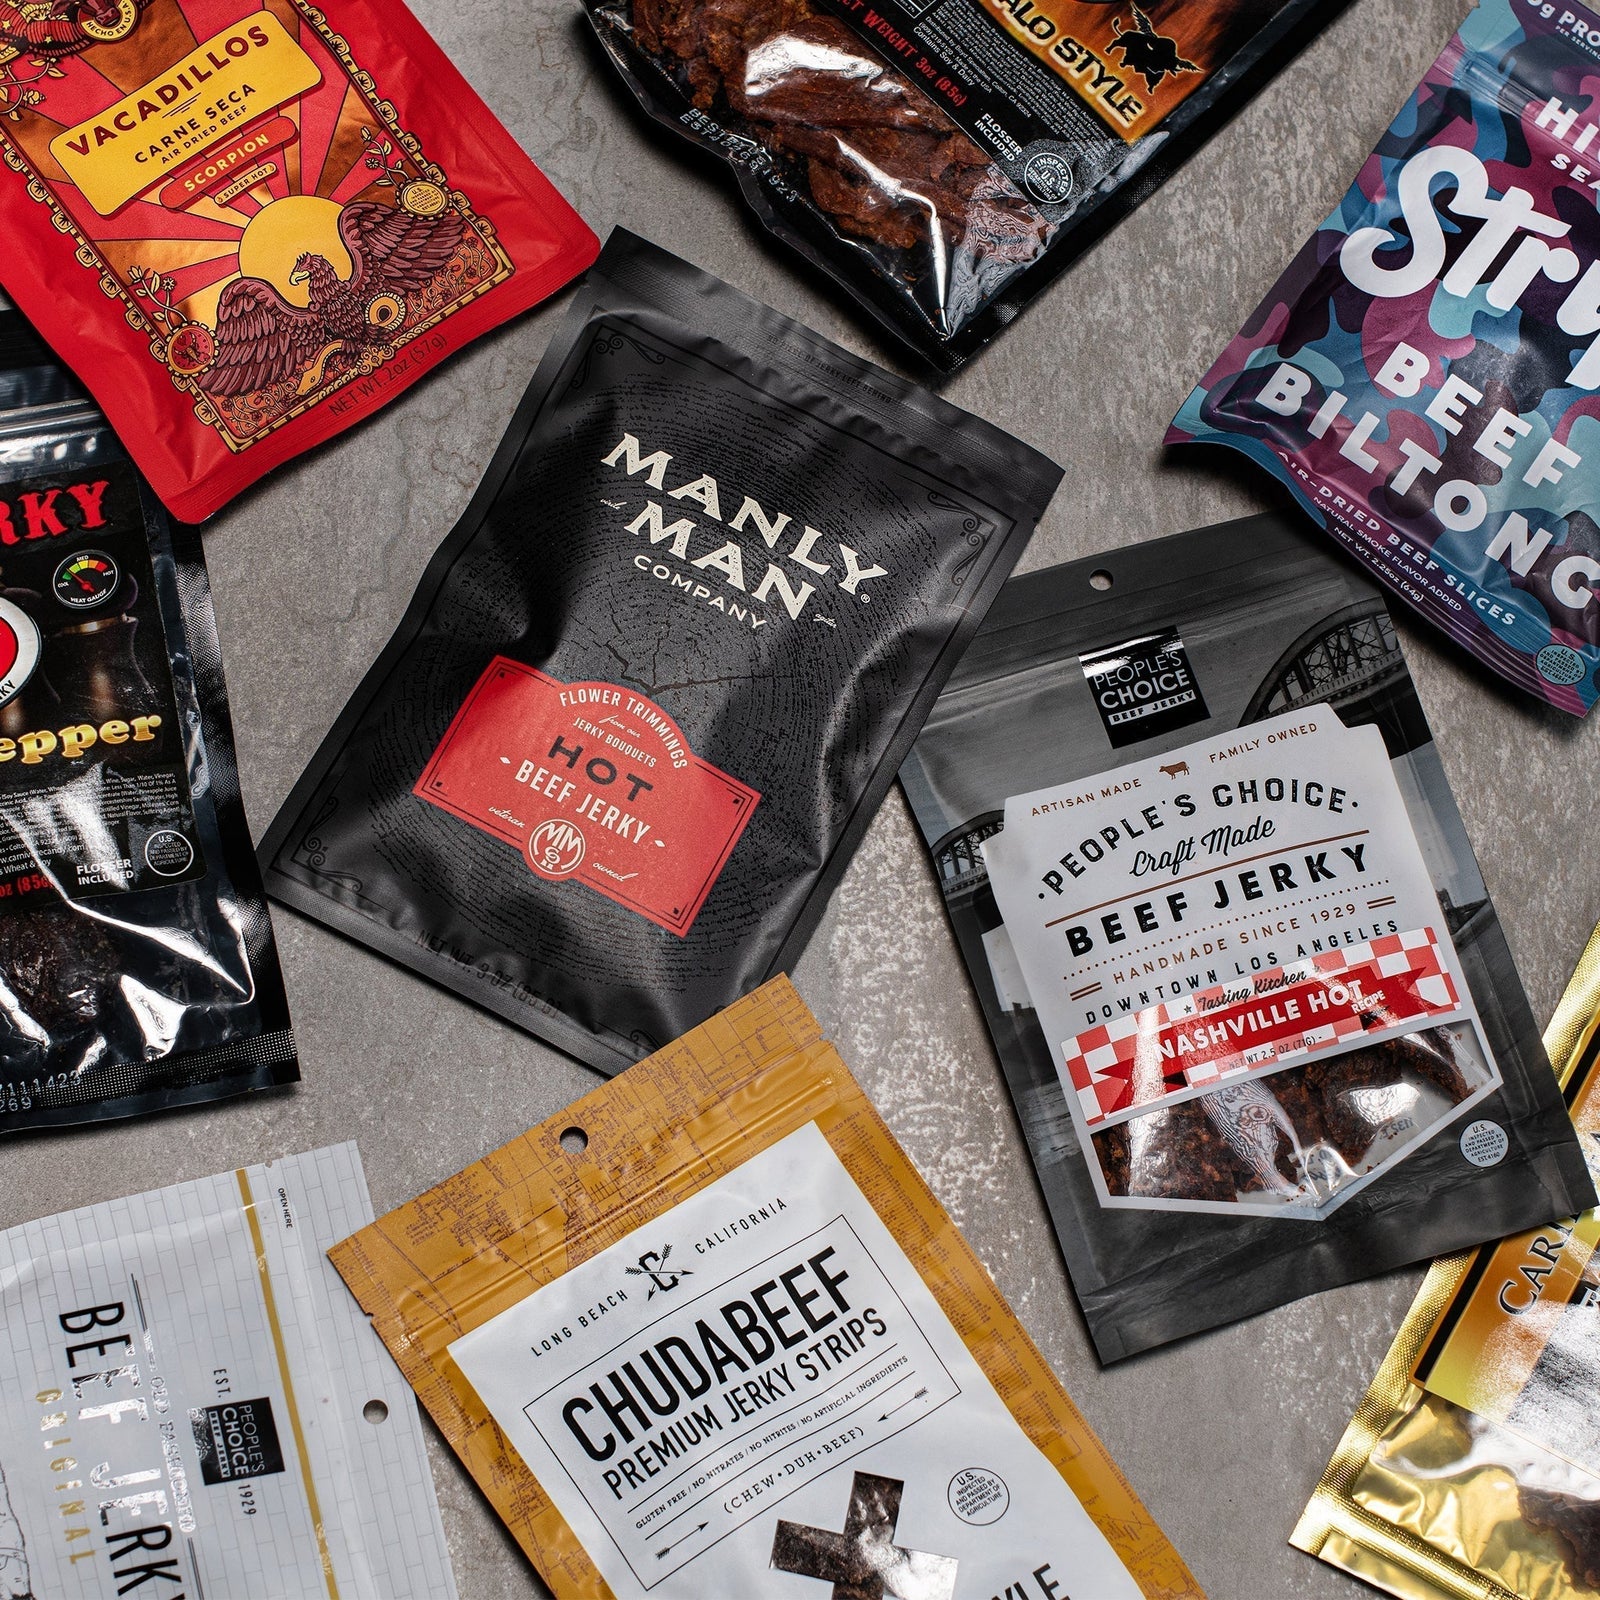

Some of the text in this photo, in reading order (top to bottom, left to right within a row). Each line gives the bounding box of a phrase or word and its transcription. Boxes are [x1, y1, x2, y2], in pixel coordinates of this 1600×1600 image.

[86, 20, 114, 37] HECHO
[113, 21, 127, 36] EN
[863, 9, 919, 58] WEIGHT
[1555, 25, 1570, 37] PER
[913, 26, 941, 53] Contains
[940, 51, 953, 65] Soy
[958, 68, 975, 86] Dairy
[925, 16, 952, 42] Distributed
[955, 45, 968, 59] Boyd
[1008, 95, 1017, 104] CA
[1053, 36, 1144, 124] STYLE
[65, 25, 270, 156] VACADILLOS
[980, 81, 993, 93] USA
[135, 83, 256, 164] CARNE SECA
[161, 105, 249, 164] AIR DRIED BEEF
[974, 119, 1016, 162] INCLUDED
[981, 112, 1023, 156] FLOSSER
[184, 133, 270, 192] SCORPION
[223, 167, 269, 199] SUPER HOT
[1036, 157, 1069, 194] INSPECTED
[1041, 170, 1056, 187] U.S.
[328, 333, 448, 417] NET WT. 2oz (57g)
[1374, 341, 1581, 489] BEEF
[1255, 362, 1600, 609] BILTONG
[601, 432, 889, 596] MANLY
[1278, 451, 1517, 626] AIR-DRIED BEEF SLICES
[76, 555, 89, 563] MED
[102, 569, 115, 577] HOT
[624, 500, 816, 620] MAN
[1313, 496, 1463, 611] NATURAL SMOKE FLAVOR ADDED
[1334, 526, 1424, 603] NET WT. 2.25oz (64g)
[70, 588, 108, 604] HEAT GAUGE
[634, 555, 768, 629] COMPANY
[1093, 650, 1182, 690] PEOPLE'S
[1100, 668, 1190, 709] CHOICE
[559, 688, 688, 769] FLOWER TRIMMINGS
[598, 714, 626, 730] from
[1112, 690, 1194, 722] BEEF JERKY
[573, 717, 657, 768] JERKY BOUQUETS
[547, 735, 654, 802] HOT
[1032, 722, 1318, 817] ARTISAN MADE FAMILY OWNED
[488, 805, 526, 829] veteran
[514, 759, 651, 844] BEEF JERKY
[158, 835, 174, 843] U.S.
[1129, 815, 1276, 877] Craft Made
[3, 862, 29, 875] Wheat
[76, 858, 132, 876] FLOSSER
[78, 870, 134, 885] INCLUDED
[592, 862, 639, 882] owned
[1065, 843, 1366, 957] BEEF JERKY
[415, 929, 448, 956] NET
[1113, 903, 1357, 984] HANDMADE SINCE 1929
[1085, 920, 1399, 1025] DOWNTOWN LOS ANGELES
[1199, 969, 1307, 1012] Tasting Kitchen
[1153, 979, 1364, 1062] NASHVILLE HOT
[1351, 990, 1386, 1014] RECIPE
[1246, 1052, 1260, 1065] WT
[1261, 1047, 1277, 1060] 2.5
[1279, 1043, 1292, 1055] OZ
[1465, 1140, 1497, 1153] DEPARTMENT
[1469, 1130, 1495, 1141] INSPECTED
[1471, 1144, 1503, 1157] AGRICULTURE
[1472, 1123, 1487, 1134] U.S.
[1476, 1136, 1494, 1144] PASSED
[277, 1187, 293, 1229] OPEN HERE
[531, 1197, 787, 1357] LONG BEACH CALIFORNIA
[59, 1301, 150, 1422] BEEF
[562, 1245, 851, 1462] CHUDABEEF
[602, 1307, 888, 1500] PREMIUM JERKY STRIPS
[209, 1412, 231, 1477] BEEF JERKY
[213, 1368, 257, 1515] EST. 1929
[222, 1407, 249, 1476] CHOICE
[239, 1404, 265, 1472] PEOPLE'S
[635, 1355, 909, 1530] GLUTEN FREE NO NITRATES NO NITRITES NO ARTIFICIAL INGREDIENTS
[36, 1387, 97, 1565] ORIGINAL
[955, 1479, 996, 1506] AND PASSED BY
[956, 1476, 986, 1496] INSPECTED
[957, 1471, 977, 1486] U.S.
[959, 1489, 994, 1513] DEPARTMENT
[966, 1492, 1003, 1516] AGRICULTURE
